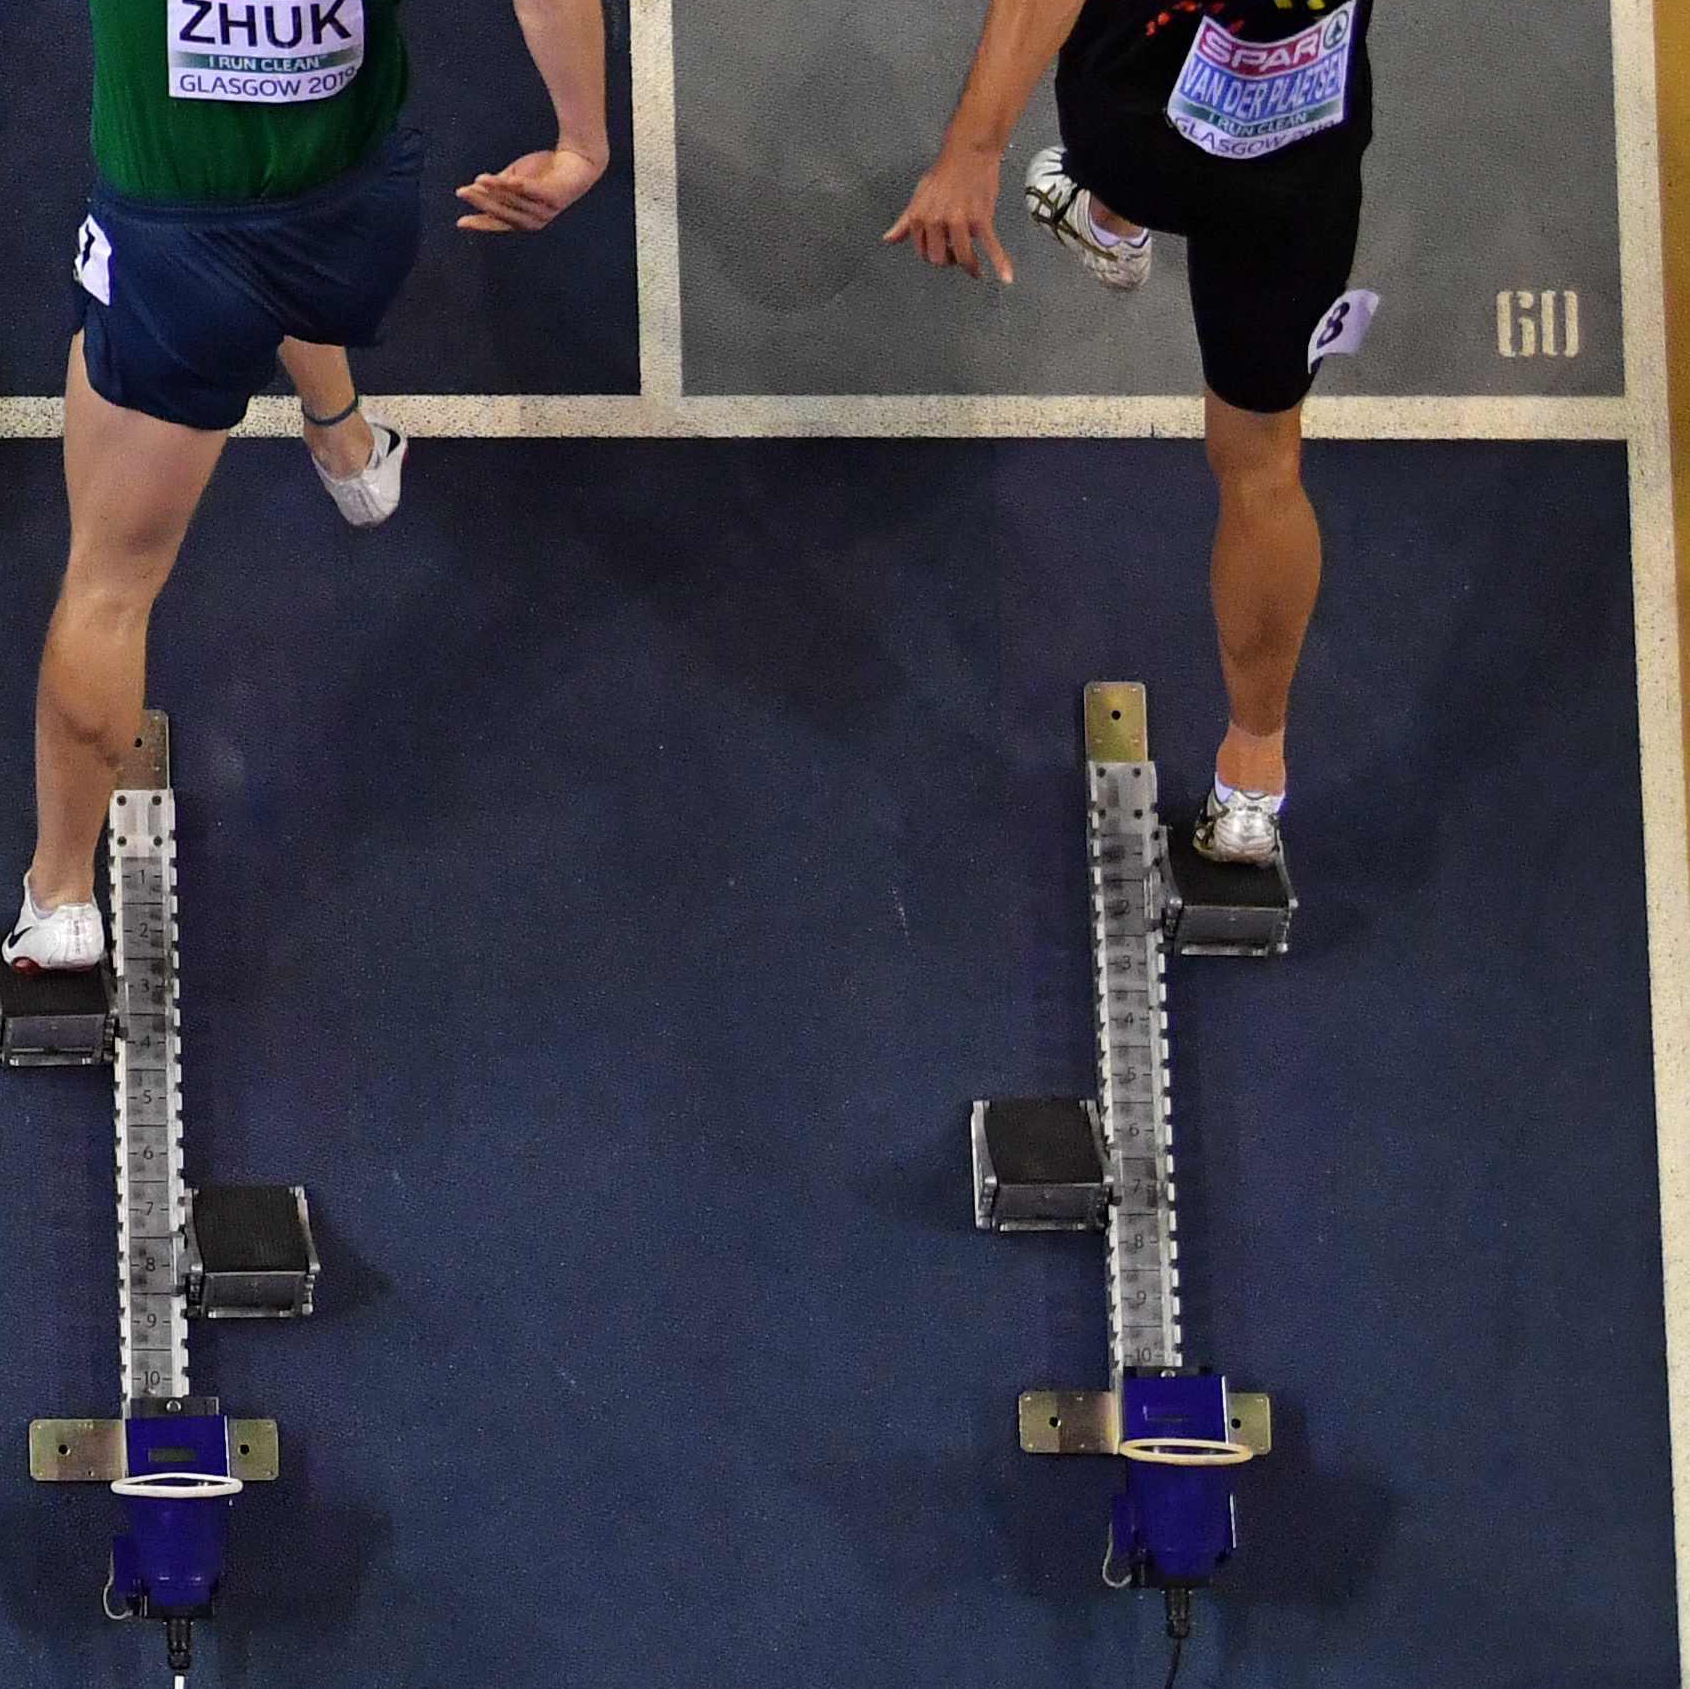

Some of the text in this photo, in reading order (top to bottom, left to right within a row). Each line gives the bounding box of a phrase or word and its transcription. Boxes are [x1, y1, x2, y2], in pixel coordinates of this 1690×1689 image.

[1200, 29, 1319, 72] SPAR
[219, 56, 257, 72] RUN
[179, 73, 301, 97] GLASGOW
[1182, 56, 1223, 107] VAN
[1223, 78, 1266, 119] DER
[1217, 117, 1254, 136] RUN
[1174, 116, 1286, 154] GLASGOW
[1496, 290, 1579, 358] 60
[139, 923, 149, 938] 2
[140, 978, 150, 993] 3
[140, 1035, 151, 1049] 4
[142, 1090, 152, 1105] 5
[142, 1145, 154, 1160] 6
[144, 1201, 154, 1216] 7
[144, 1256, 156, 1272] 8
[145, 1314, 157, 1329] 9
[143, 1370, 161, 1386] 10
